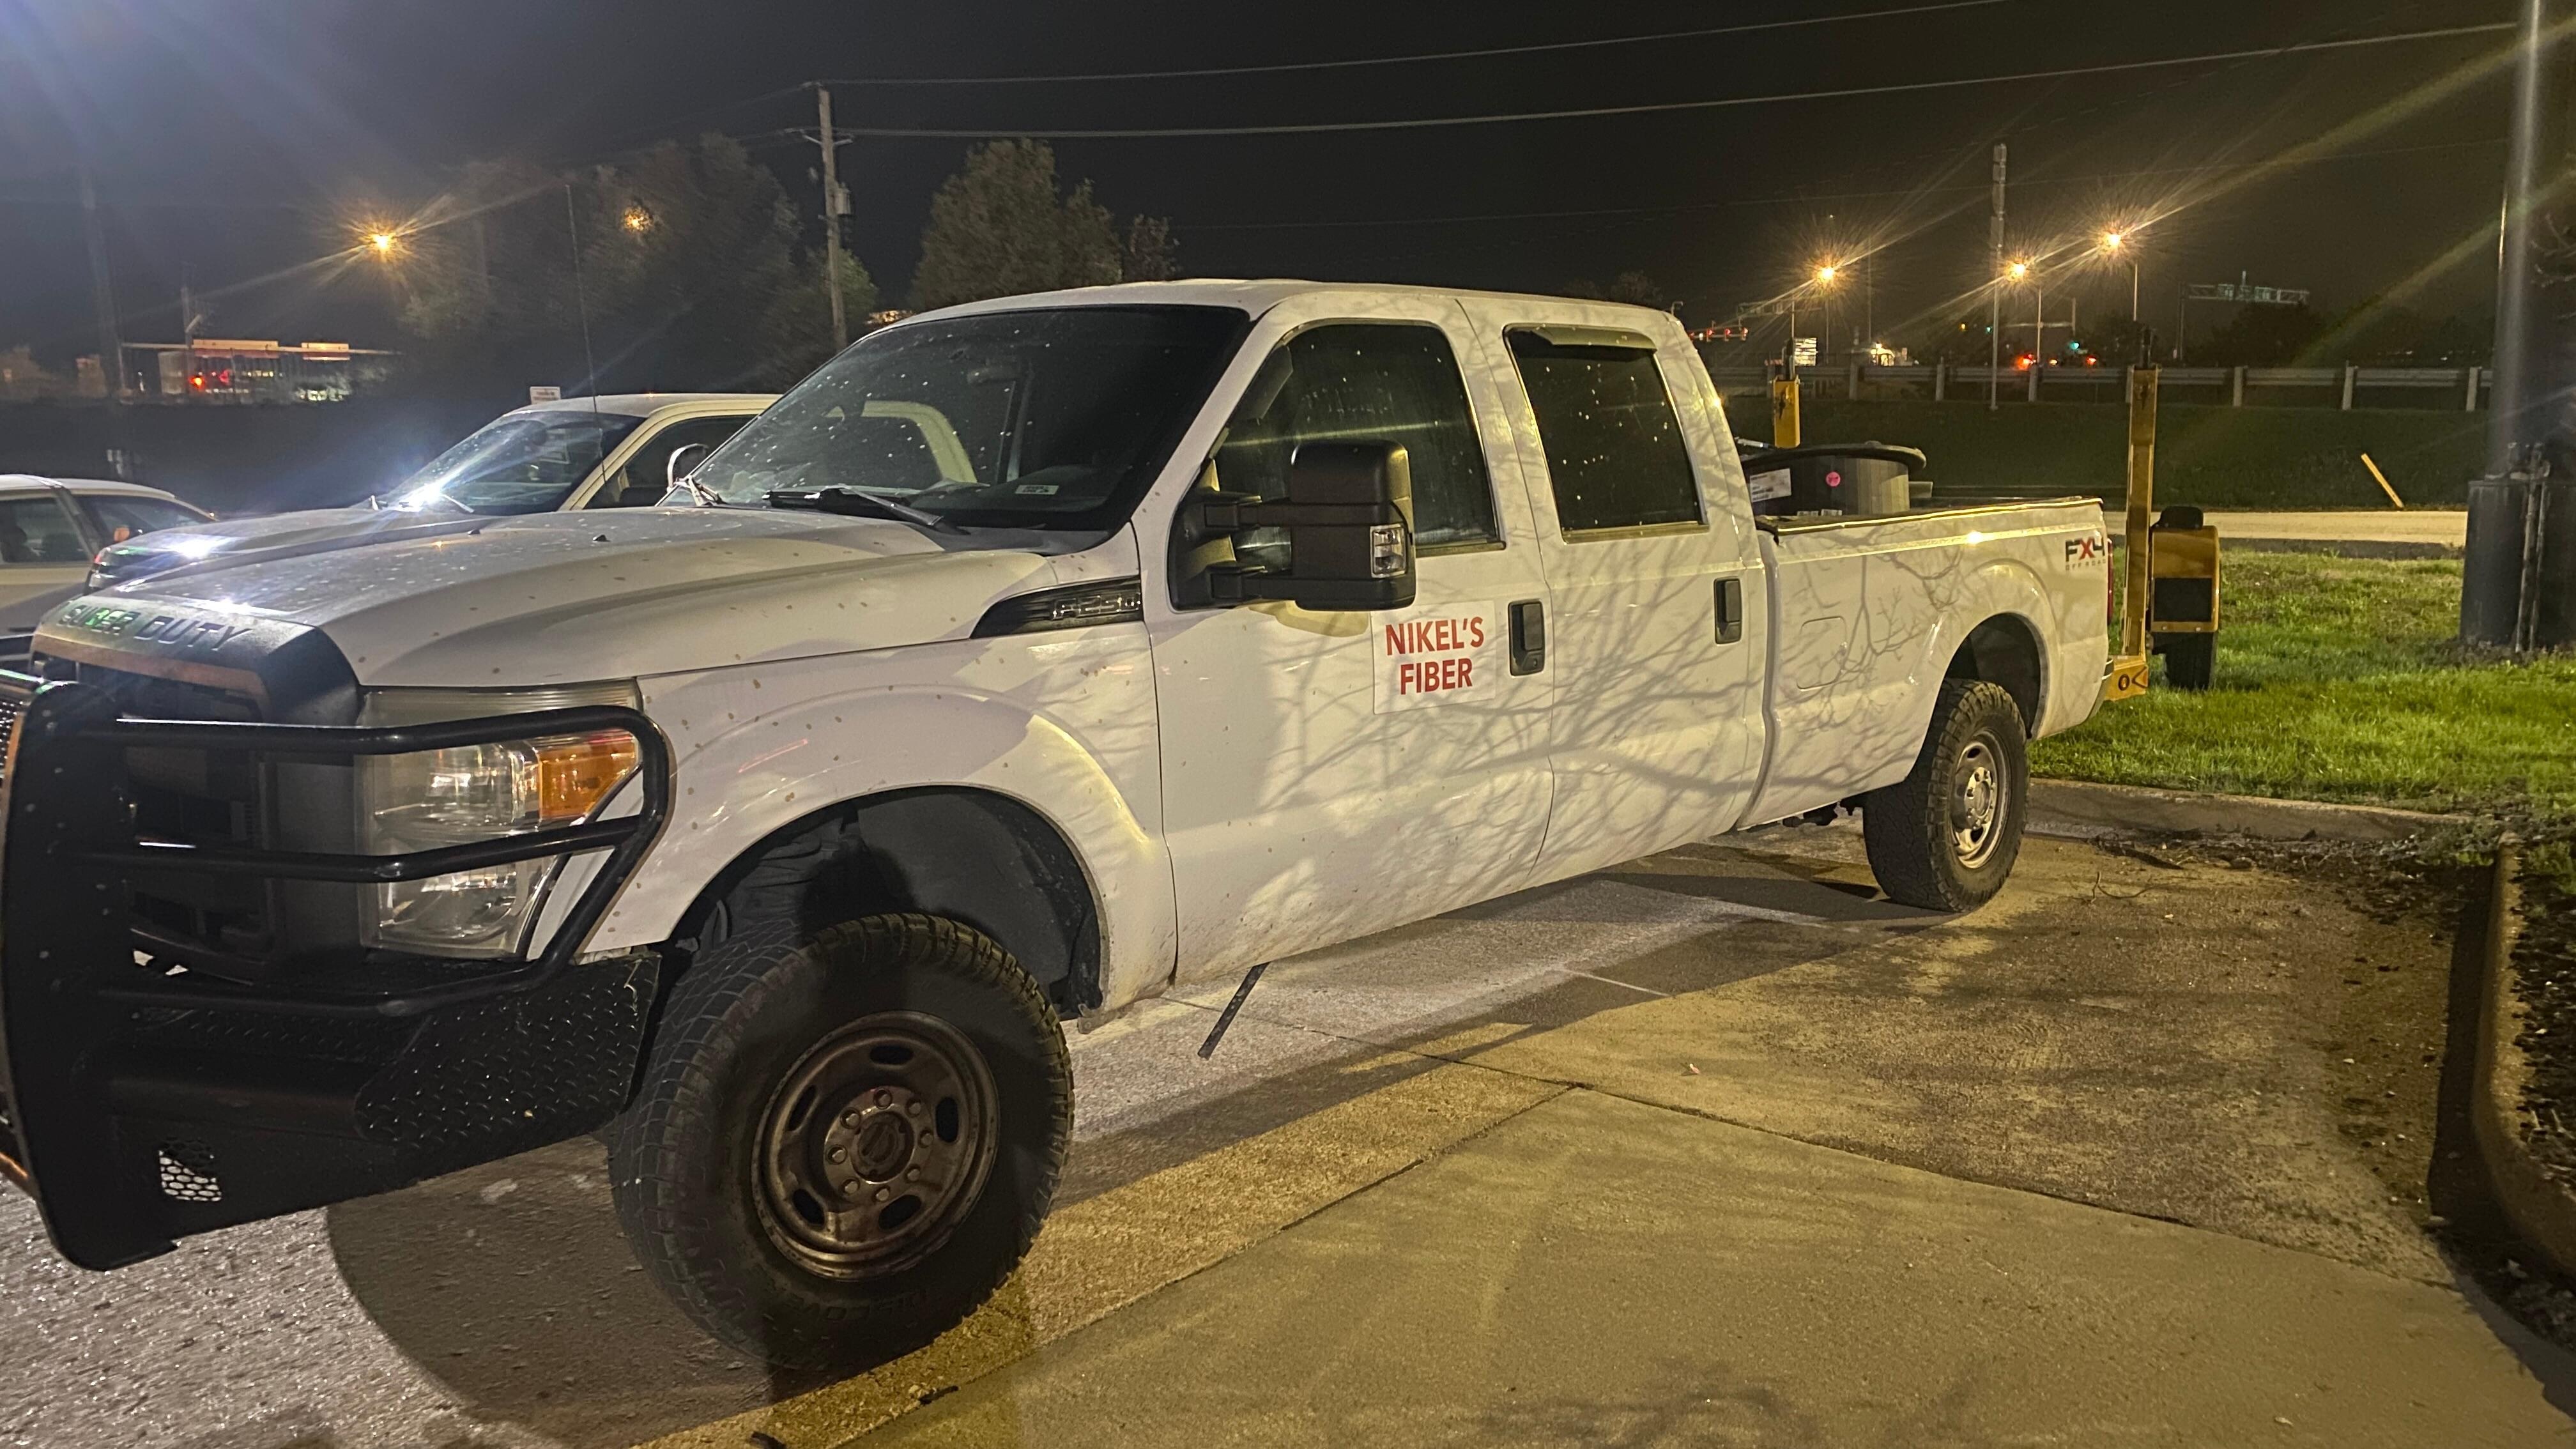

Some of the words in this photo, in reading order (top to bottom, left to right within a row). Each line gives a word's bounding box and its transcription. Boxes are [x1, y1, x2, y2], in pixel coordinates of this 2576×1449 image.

[2066, 537, 2105, 562] FX4
[134, 615, 253, 651] DUTY
[1385, 617, 1485, 656] NIKEL'S
[1400, 657, 1473, 695] FIBER
